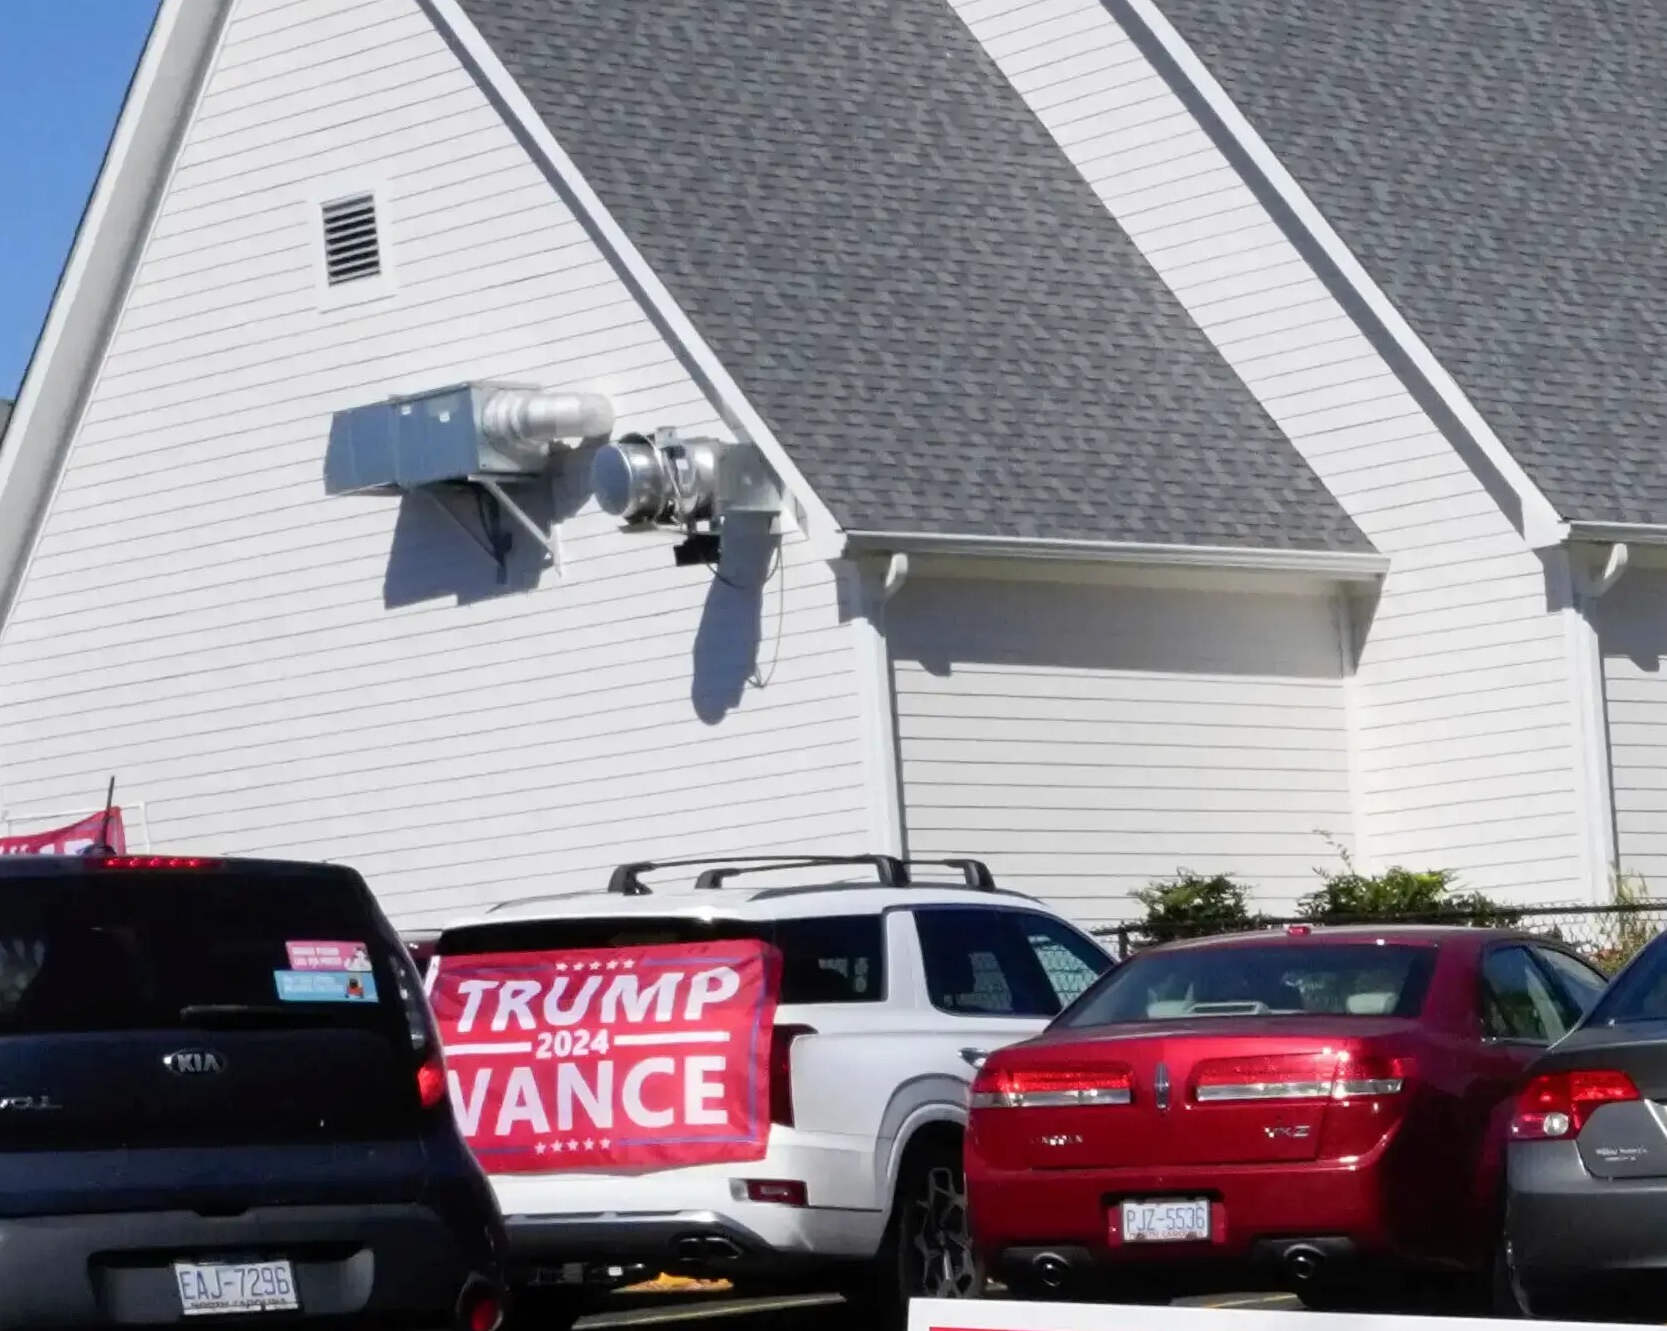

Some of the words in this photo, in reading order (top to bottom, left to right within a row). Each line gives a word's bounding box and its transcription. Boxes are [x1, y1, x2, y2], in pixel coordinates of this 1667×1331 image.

[456, 966, 740, 1033] TRUMP
[535, 1029, 610, 1059] 2024
[177, 1053, 220, 1072] KIA
[447, 1055, 728, 1137] VANCE
[1126, 1206, 1205, 1232] PJZ-5536
[179, 1267, 290, 1300] EAJ-7296
